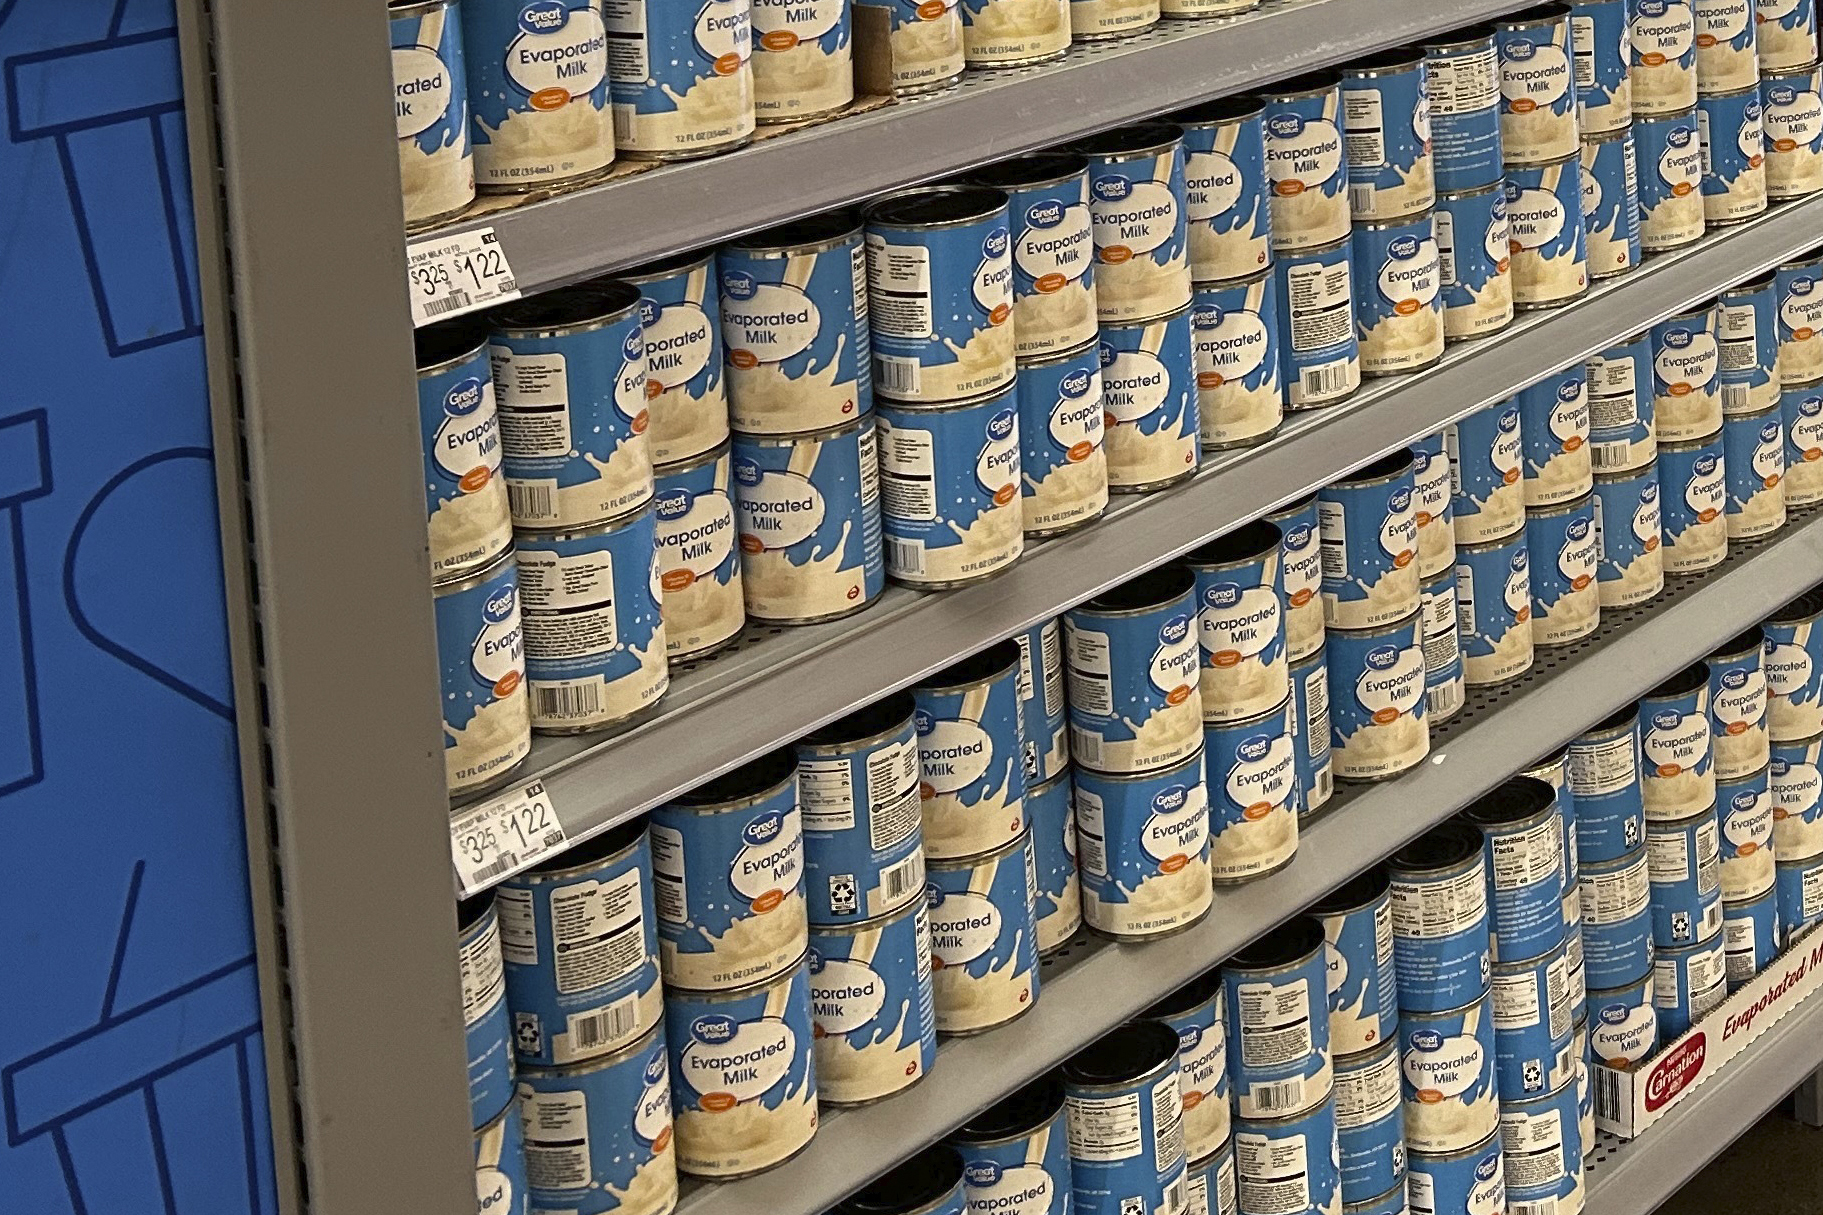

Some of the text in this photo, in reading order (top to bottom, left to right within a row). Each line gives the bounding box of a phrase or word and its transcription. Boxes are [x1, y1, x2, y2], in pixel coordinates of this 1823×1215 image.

[524, 7, 562, 24] Great
[785, 4, 818, 24] Milk
[1635, 22, 1691, 38] Evaporated
[1706, 18, 1729, 29] Milk
[1657, 34, 1678, 47] Milk
[519, 34, 605, 65] Evaporated
[555, 59, 588, 79] Milk
[1502, 64, 1565, 82] Evaporated
[1526, 79, 1550, 92] Milk
[1788, 121, 1809, 134] Milk
[1267, 141, 1338, 162] Evaporated
[1293, 158, 1320, 172] Milk
[1095, 180, 1126, 195] Great
[1030, 206, 1060, 222] Great
[1092, 203, 1172, 227] Evaporated
[1120, 223, 1150, 238] Milk
[1026, 228, 1092, 256] Evaporated
[1055, 249, 1080, 267] Milk
[411, 250, 506, 295] $325 $122
[1411, 277, 1431, 291] Milk
[745, 328, 777, 345] Milk
[648, 351, 683, 368] Milk
[1212, 350, 1240, 365] Milk
[1683, 363, 1704, 377] Milk
[752, 515, 782, 532] Milk
[681, 541, 712, 562] Milk
[1203, 604, 1276, 632] Evaporated
[1230, 626, 1258, 642] Milk
[1389, 684, 1412, 701] Milk
[1740, 701, 1757, 716] Milk
[1651, 725, 1707, 749] Evaporated
[1673, 744, 1694, 759] Milk
[923, 762, 956, 777] Milk
[500, 803, 550, 848] $122
[932, 932, 963, 950] Milk
[1722, 956, 1807, 1042] Evaporated
[813, 1001, 844, 1017] Milk
[1621, 1037, 1642, 1052] Milk
[690, 1038, 787, 1070] Evaporated
[1409, 1050, 1478, 1072] Evaporated
[723, 1064, 760, 1084] Milk
[1433, 1070, 1459, 1084] Milk
[1648, 1044, 1704, 1101] Carnation
